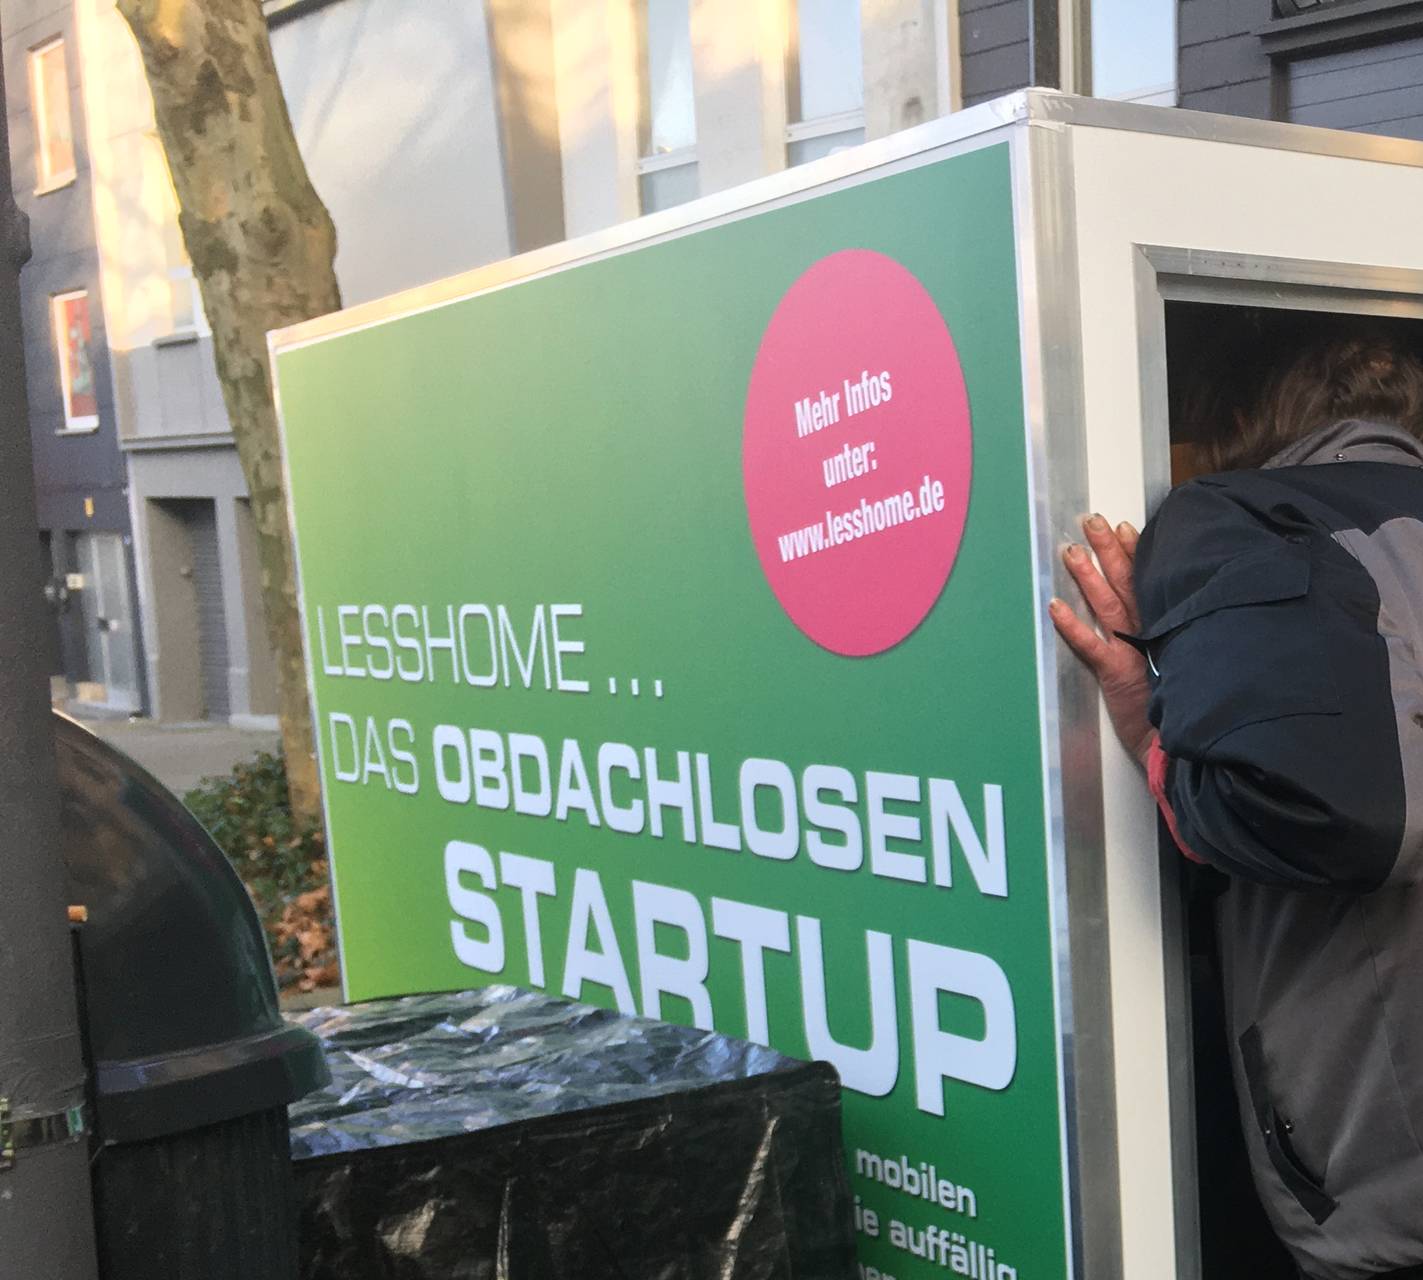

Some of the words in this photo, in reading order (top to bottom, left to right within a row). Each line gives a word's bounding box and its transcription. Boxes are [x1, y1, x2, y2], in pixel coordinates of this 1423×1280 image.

[795, 391, 840, 438] Mehr
[844, 370, 892, 416] Infos
[823, 441, 877, 487] unter:
[778, 475, 944, 562] www.lesshome.de
[318, 604, 590, 692] LESSHOME
[329, 712, 420, 795] DAS
[432, 724, 1008, 898] OBDACHLOSEN
[444, 840, 1017, 1116] STARTUP
[854, 1194, 880, 1237] ie
[856, 1148, 977, 1217] mobilen
